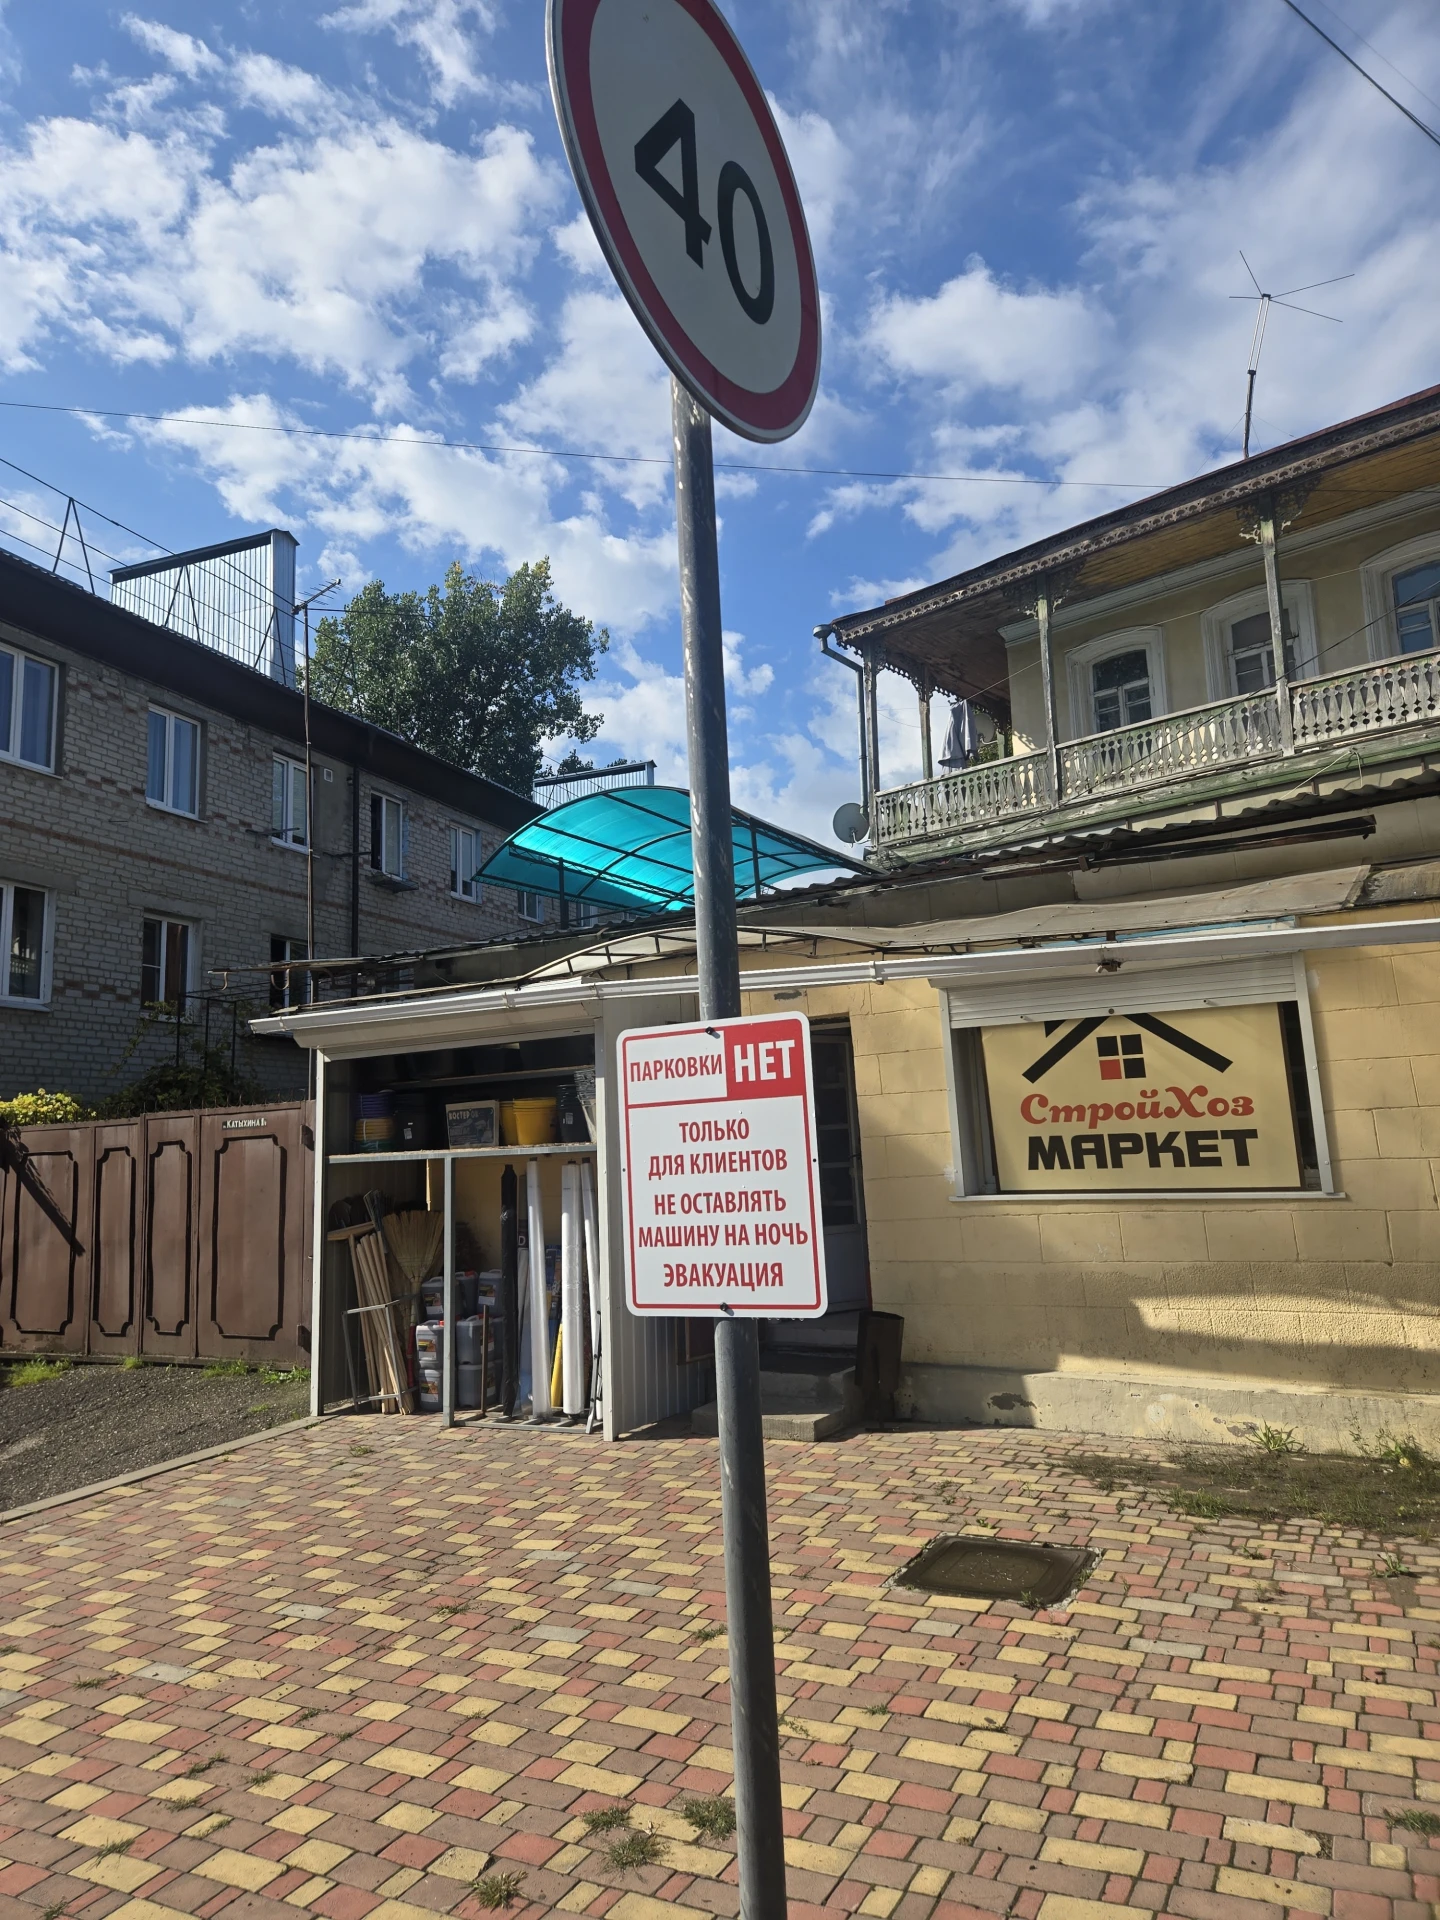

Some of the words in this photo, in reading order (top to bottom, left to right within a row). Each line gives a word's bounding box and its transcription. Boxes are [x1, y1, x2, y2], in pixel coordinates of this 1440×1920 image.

[634, 97, 775, 325] 40
[630, 1055, 723, 1081] ПАРКОВКИ
[734, 1040, 795, 1082] НЕТ
[1021, 1085, 1254, 1128] СтройХоз
[679, 1119, 750, 1142] ТОЛЬКО
[648, 1155, 685, 1180] ДЛЯ
[690, 1149, 787, 1174] КЛИЕНТОВ
[1028, 1129, 1258, 1170] МАРКЕТ
[654, 1195, 675, 1215] НЕ
[680, 1190, 786, 1214] ОСТАВЛЯТЬ
[639, 1227, 719, 1247] МАШИНУ
[725, 1225, 749, 1245] НА
[754, 1224, 808, 1245] НОЧЬ
[664, 1263, 783, 1290] ЭВАКУАЦИЯ
